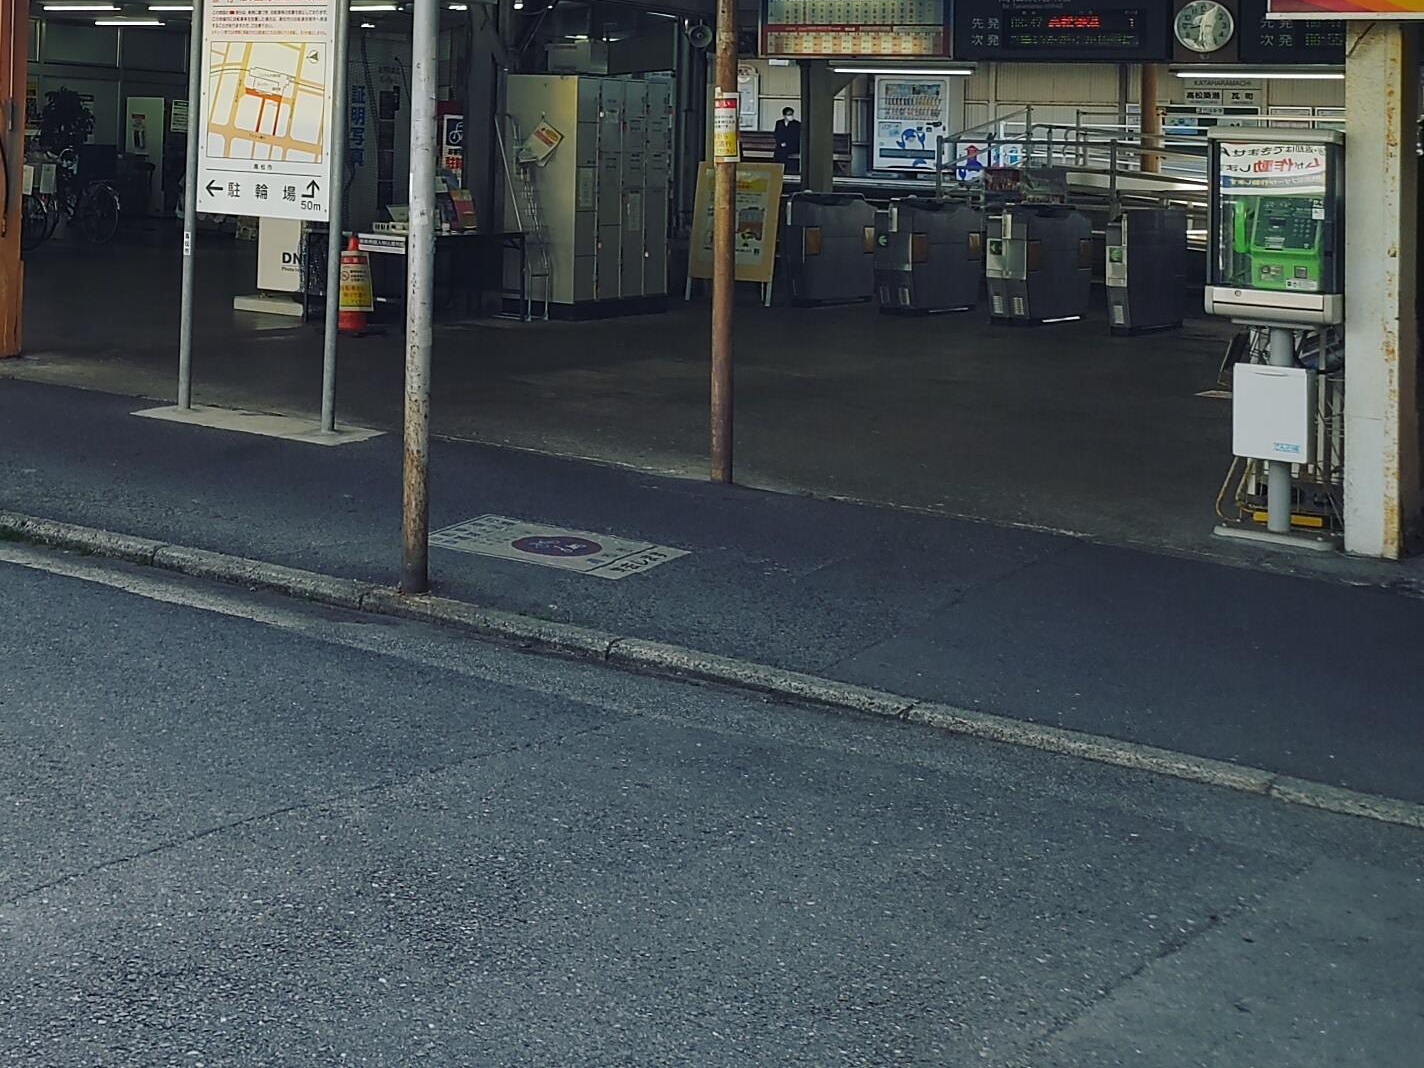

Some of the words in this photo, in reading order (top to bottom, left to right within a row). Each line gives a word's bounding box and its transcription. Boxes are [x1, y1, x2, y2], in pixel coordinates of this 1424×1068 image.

[972, 18, 1000, 29] 先発
[972, 35, 1000, 46] 次発
[1260, 34, 1293, 47] 次発
[300, 200, 321, 211] 50m
[282, 252, 303, 265] DN
